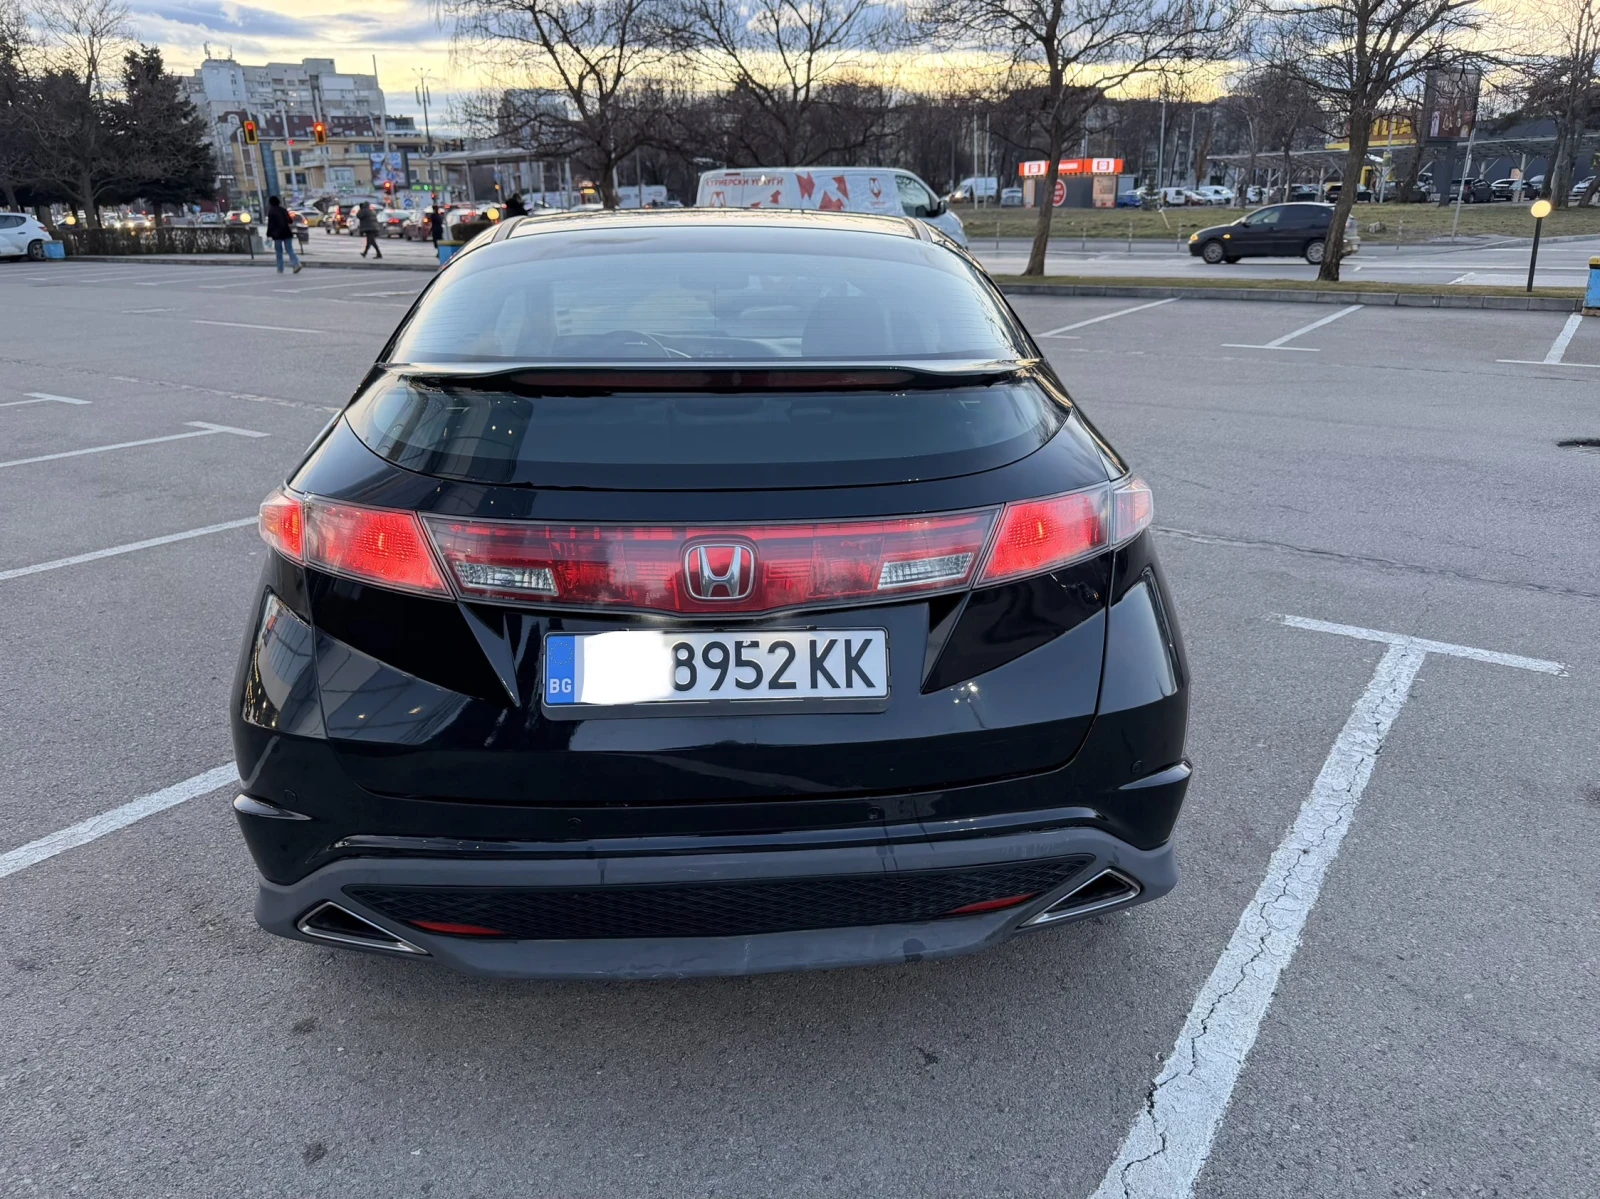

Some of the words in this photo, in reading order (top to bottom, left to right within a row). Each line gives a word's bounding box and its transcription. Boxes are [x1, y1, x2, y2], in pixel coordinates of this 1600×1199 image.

[671, 640, 797, 691] 8952
[809, 638, 876, 690] KK
[549, 678, 572, 693] BG
